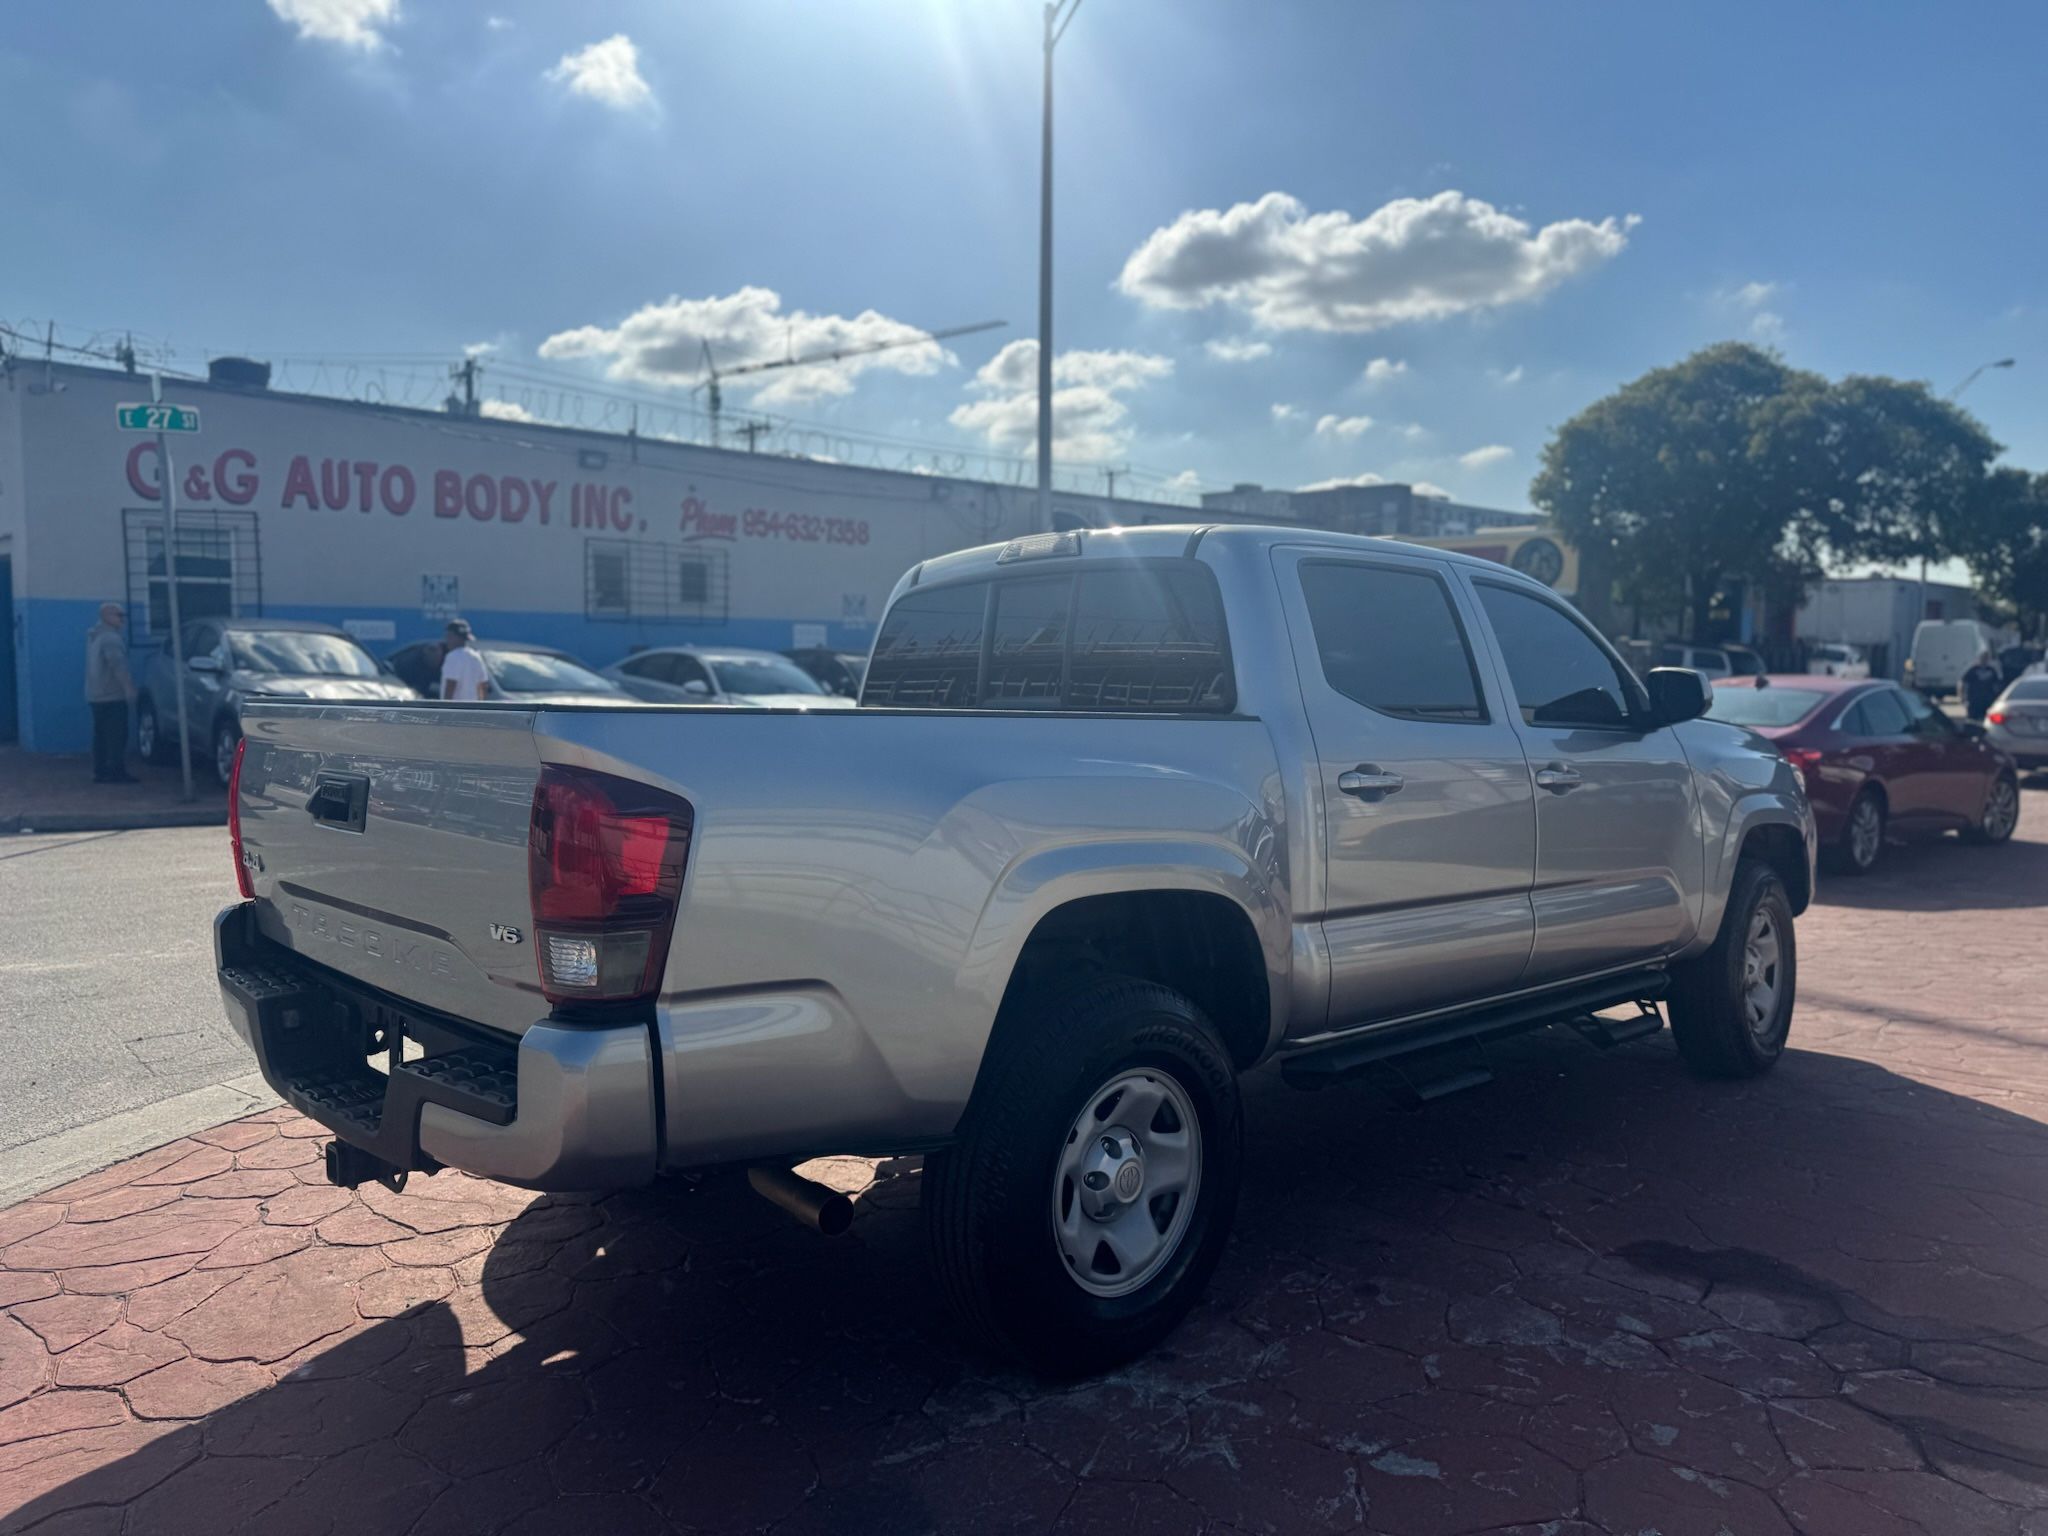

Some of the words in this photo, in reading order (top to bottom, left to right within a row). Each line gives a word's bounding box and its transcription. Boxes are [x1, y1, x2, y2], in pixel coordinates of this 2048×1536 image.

[124, 411, 134, 426] E
[146, 407, 172, 430] 27
[181, 413, 195, 429] ST
[281, 455, 417, 517] AUTO
[434, 469, 558, 526] BODY
[570, 481, 648, 533] INC.
[488, 922, 521, 945] V6
